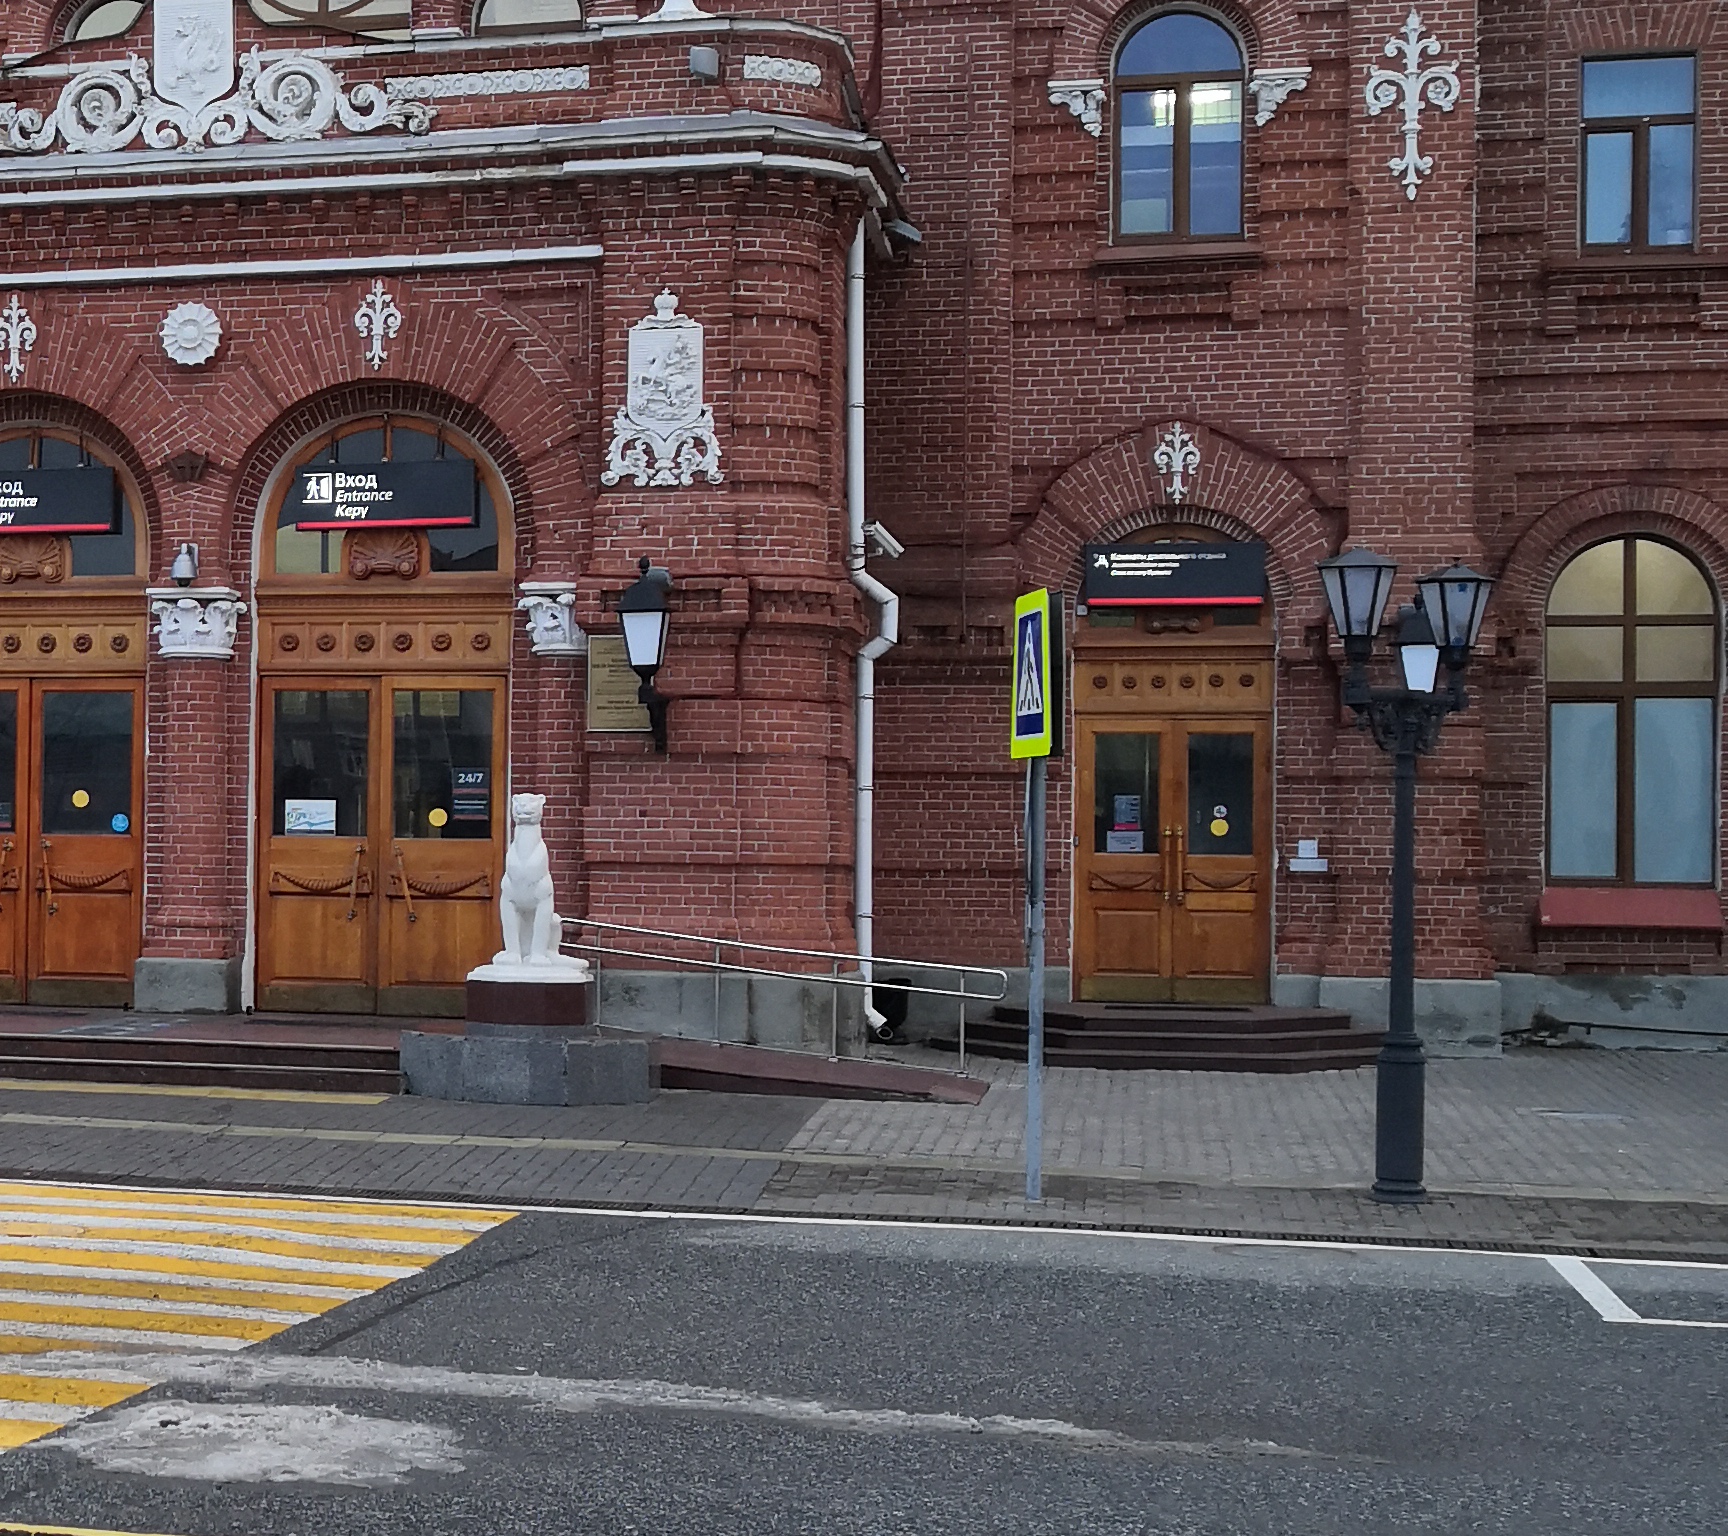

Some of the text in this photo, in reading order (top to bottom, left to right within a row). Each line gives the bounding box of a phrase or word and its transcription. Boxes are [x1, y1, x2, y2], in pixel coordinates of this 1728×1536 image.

[334, 472, 378, 490] Вход
[334, 489, 394, 503] Entrance
[458, 772, 484, 784] 24/7
